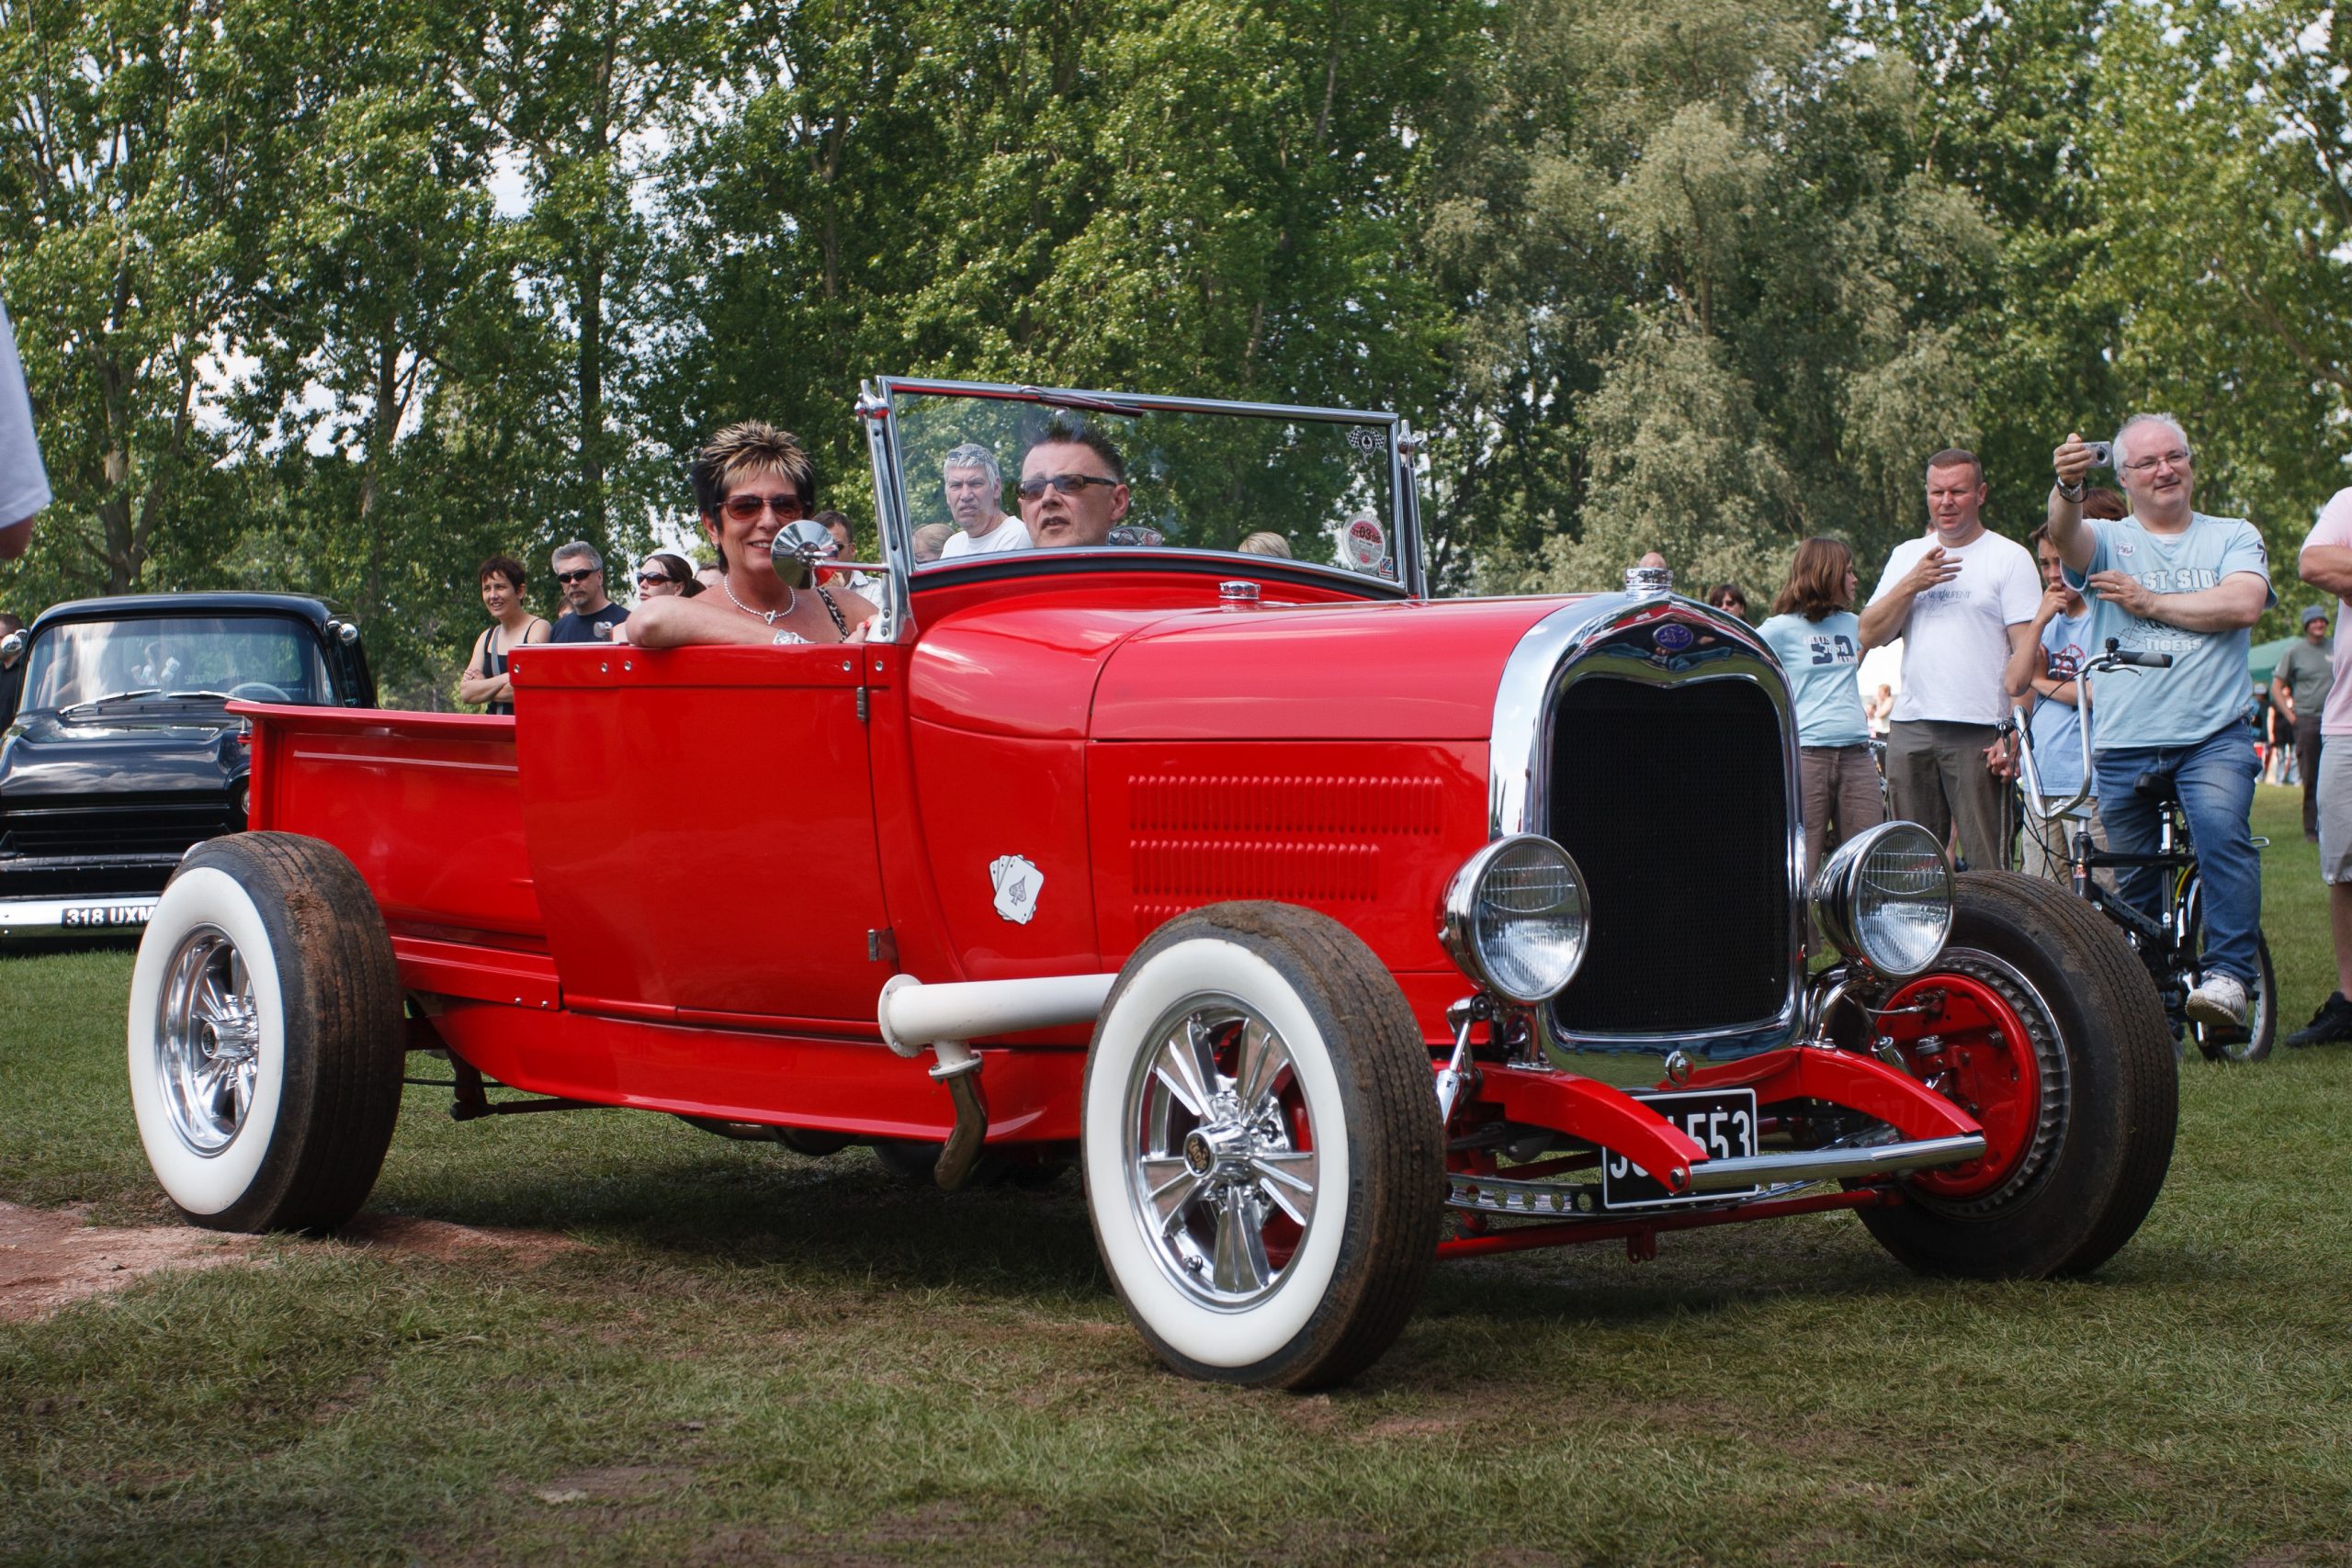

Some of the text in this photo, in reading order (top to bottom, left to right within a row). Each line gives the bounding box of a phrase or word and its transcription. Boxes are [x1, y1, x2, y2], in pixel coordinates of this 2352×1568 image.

[2144, 637, 2203, 652] TIGERS
[66, 908, 104, 926] 318
[1687, 1110, 1751, 1159] 553
